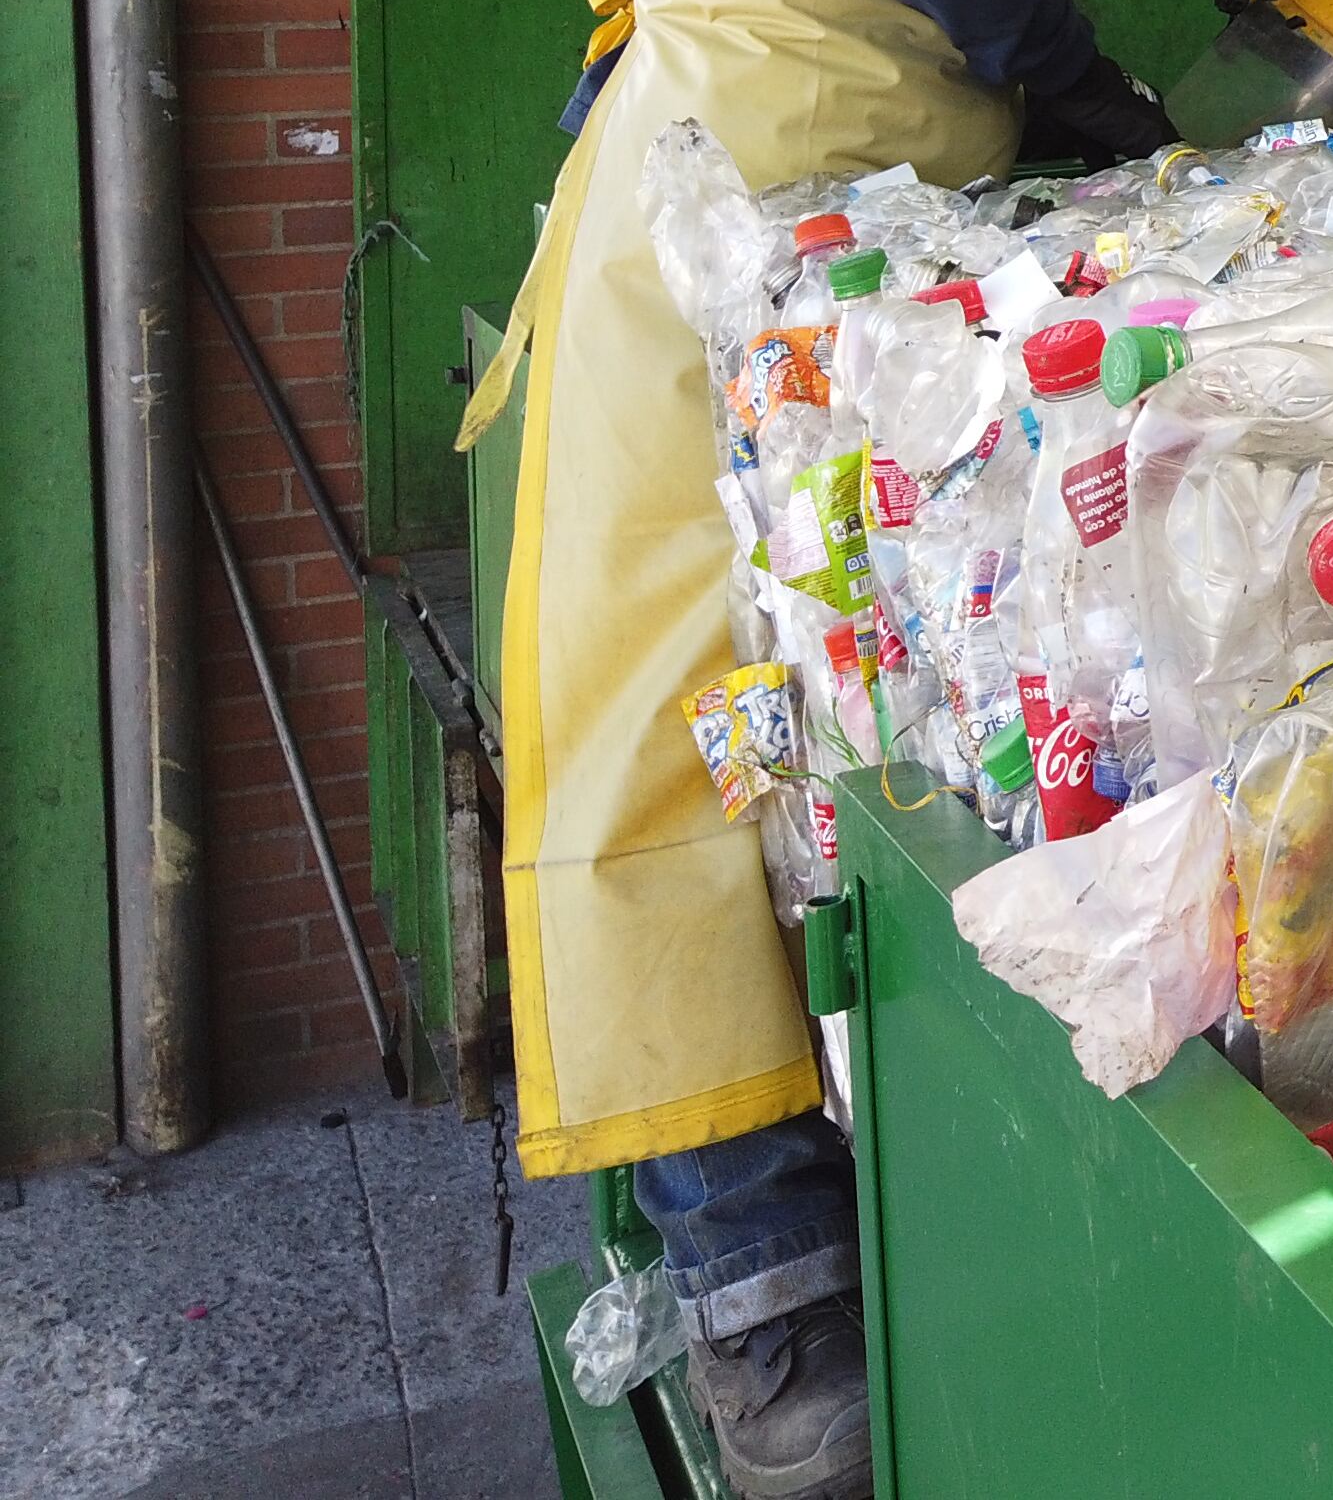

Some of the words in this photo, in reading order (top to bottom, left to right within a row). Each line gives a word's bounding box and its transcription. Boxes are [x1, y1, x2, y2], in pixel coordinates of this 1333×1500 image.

[1102, 467, 1117, 480] de
[1083, 479, 1124, 504] brillante
[1078, 500, 1114, 522] natural
